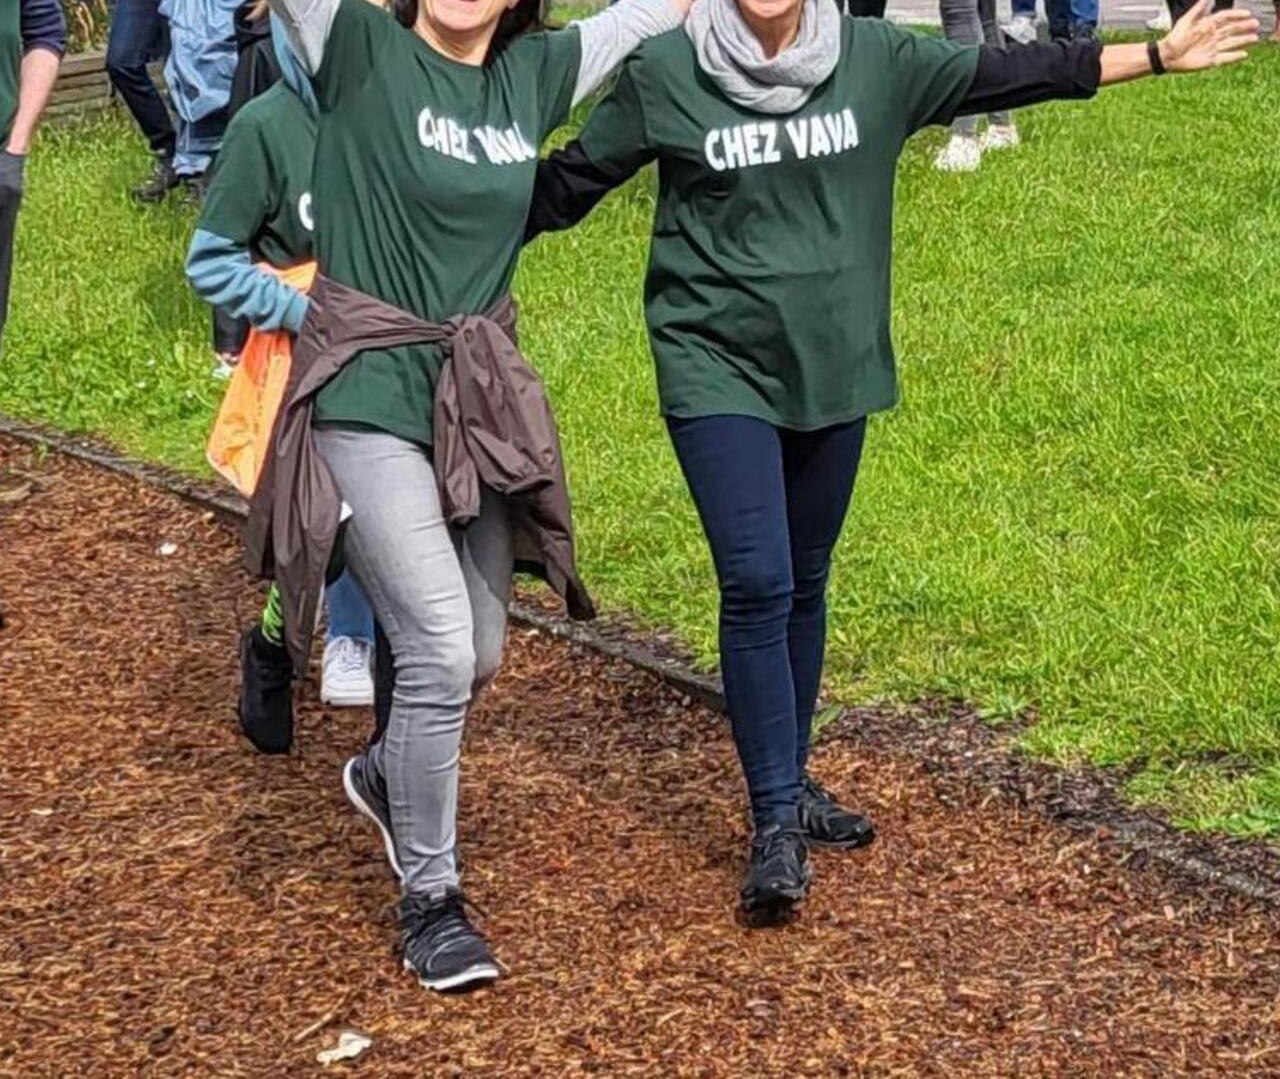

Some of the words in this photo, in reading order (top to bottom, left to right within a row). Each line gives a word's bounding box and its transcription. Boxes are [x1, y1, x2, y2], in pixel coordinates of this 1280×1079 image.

[417, 107, 477, 165] CHEZ
[474, 121, 537, 165] VAVA
[704, 121, 781, 171] CHEZ
[785, 107, 860, 160] VAVA
